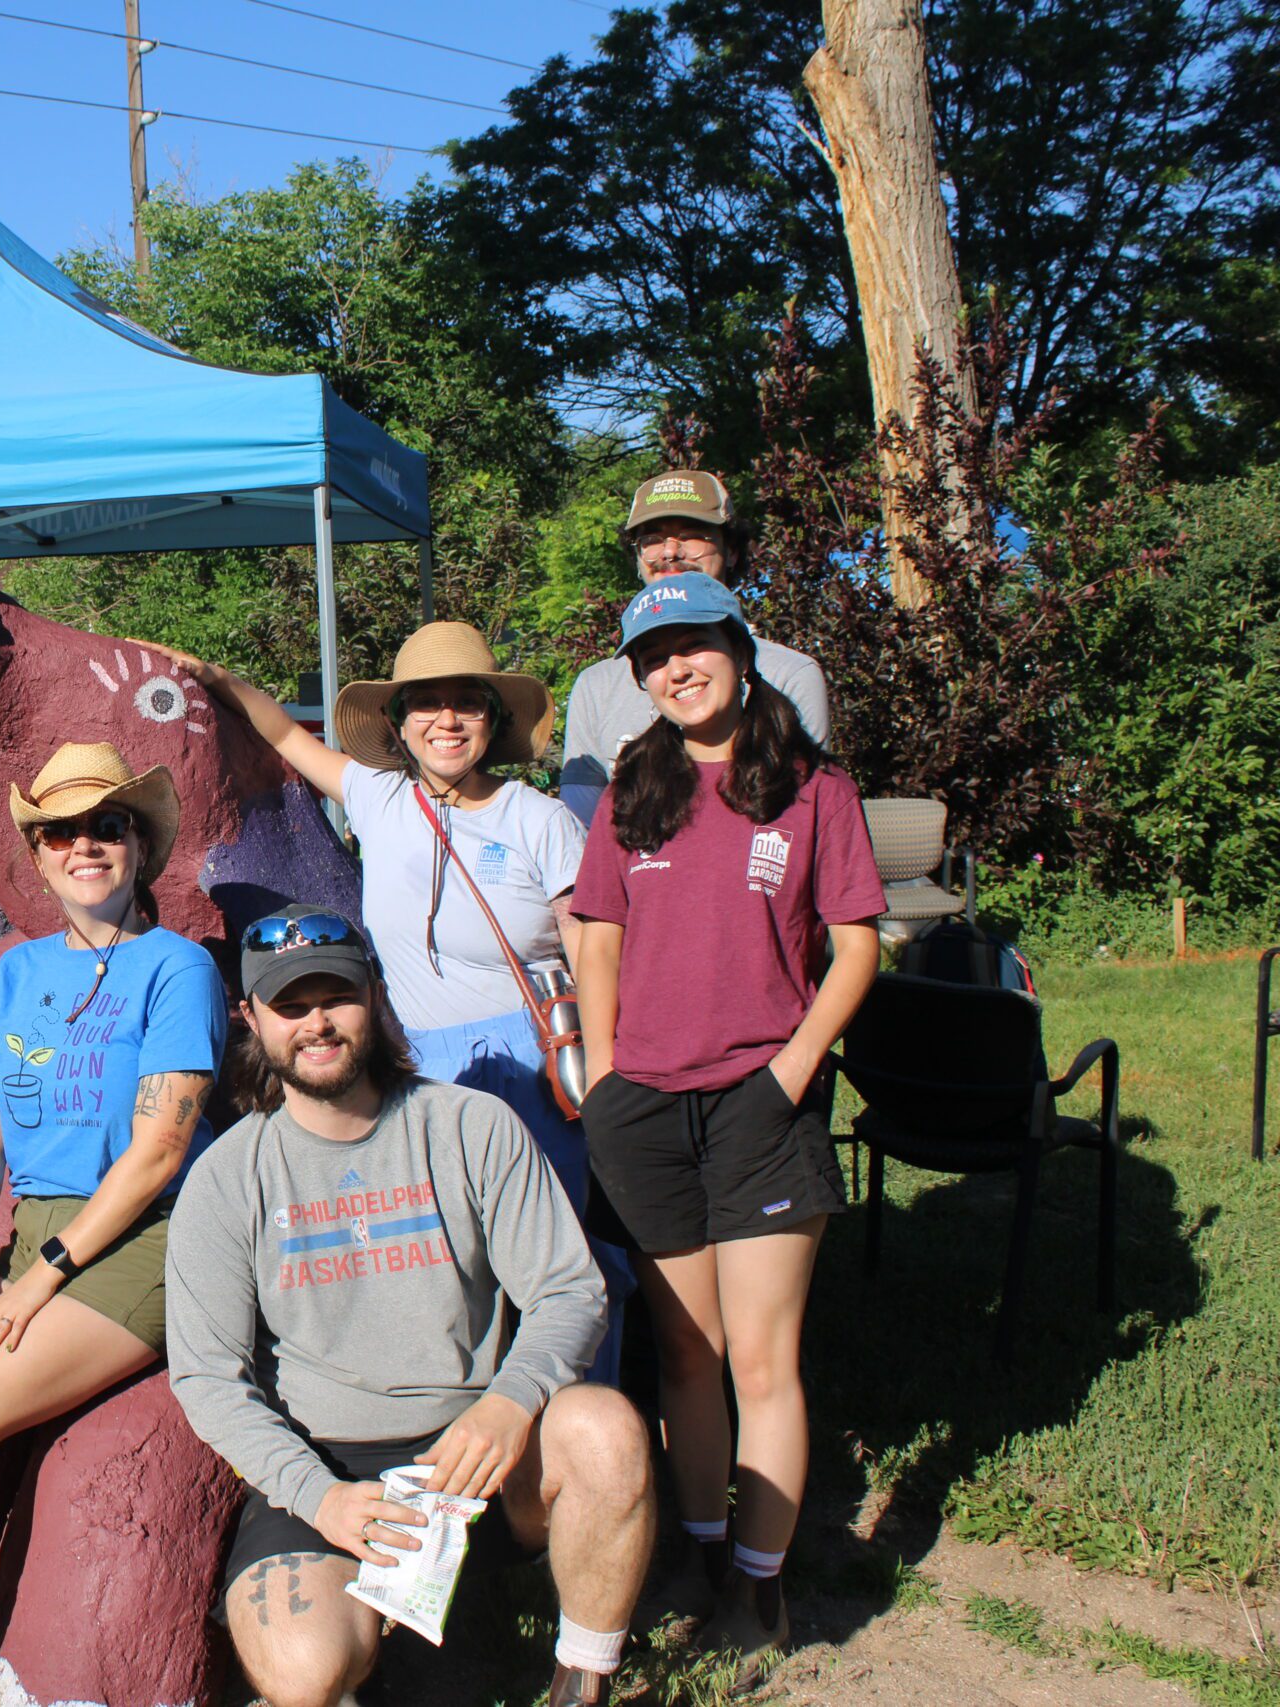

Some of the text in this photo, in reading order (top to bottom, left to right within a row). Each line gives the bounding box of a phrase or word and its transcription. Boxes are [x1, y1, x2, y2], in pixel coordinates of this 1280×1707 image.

[653, 485, 696, 494] MASTER
[654, 478, 695, 488] DENVER
[652, 587, 688, 602] TAM
[749, 865, 784, 885] GARDENS
[63, 1020, 117, 1047] YOUR
[56, 1051, 105, 1080] OWN
[54, 1084, 104, 1113] WAY
[279, 1236, 454, 1291] BASKETBALL
